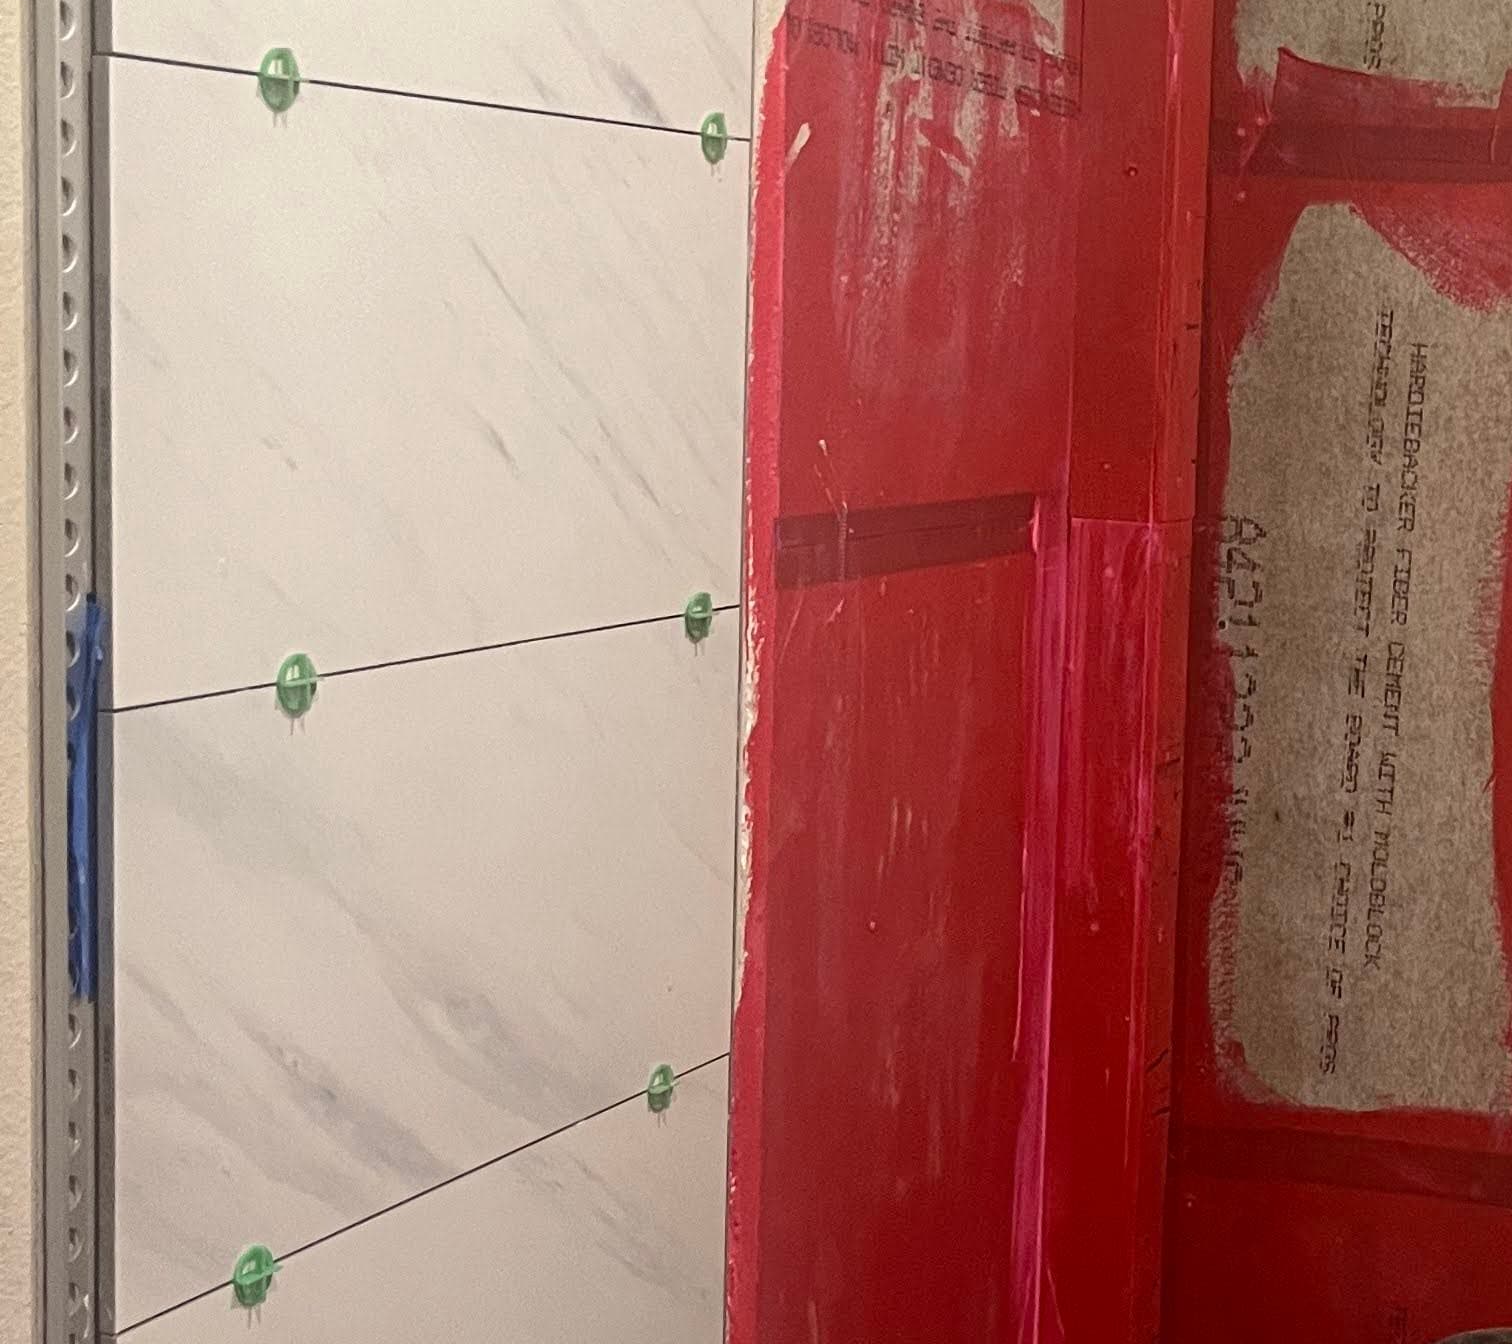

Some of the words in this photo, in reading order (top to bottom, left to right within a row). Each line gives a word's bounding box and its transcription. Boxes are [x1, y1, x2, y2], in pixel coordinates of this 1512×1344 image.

[1365, 309, 1394, 467] TECHNOLOGY
[1395, 342, 1429, 532] HARDIEBACKER
[1360, 483, 1381, 513] TO
[1352, 527, 1377, 639] PROTECT
[1390, 548, 1413, 626] FIBER
[1347, 652, 1368, 699] THE
[1382, 641, 1406, 737] CEMENT
[1340, 713, 1363, 794] BOARD
[1376, 752, 1399, 817] WITH
[1327, 861, 1352, 955] CHOICE
[1325, 966, 1344, 1000] OF
